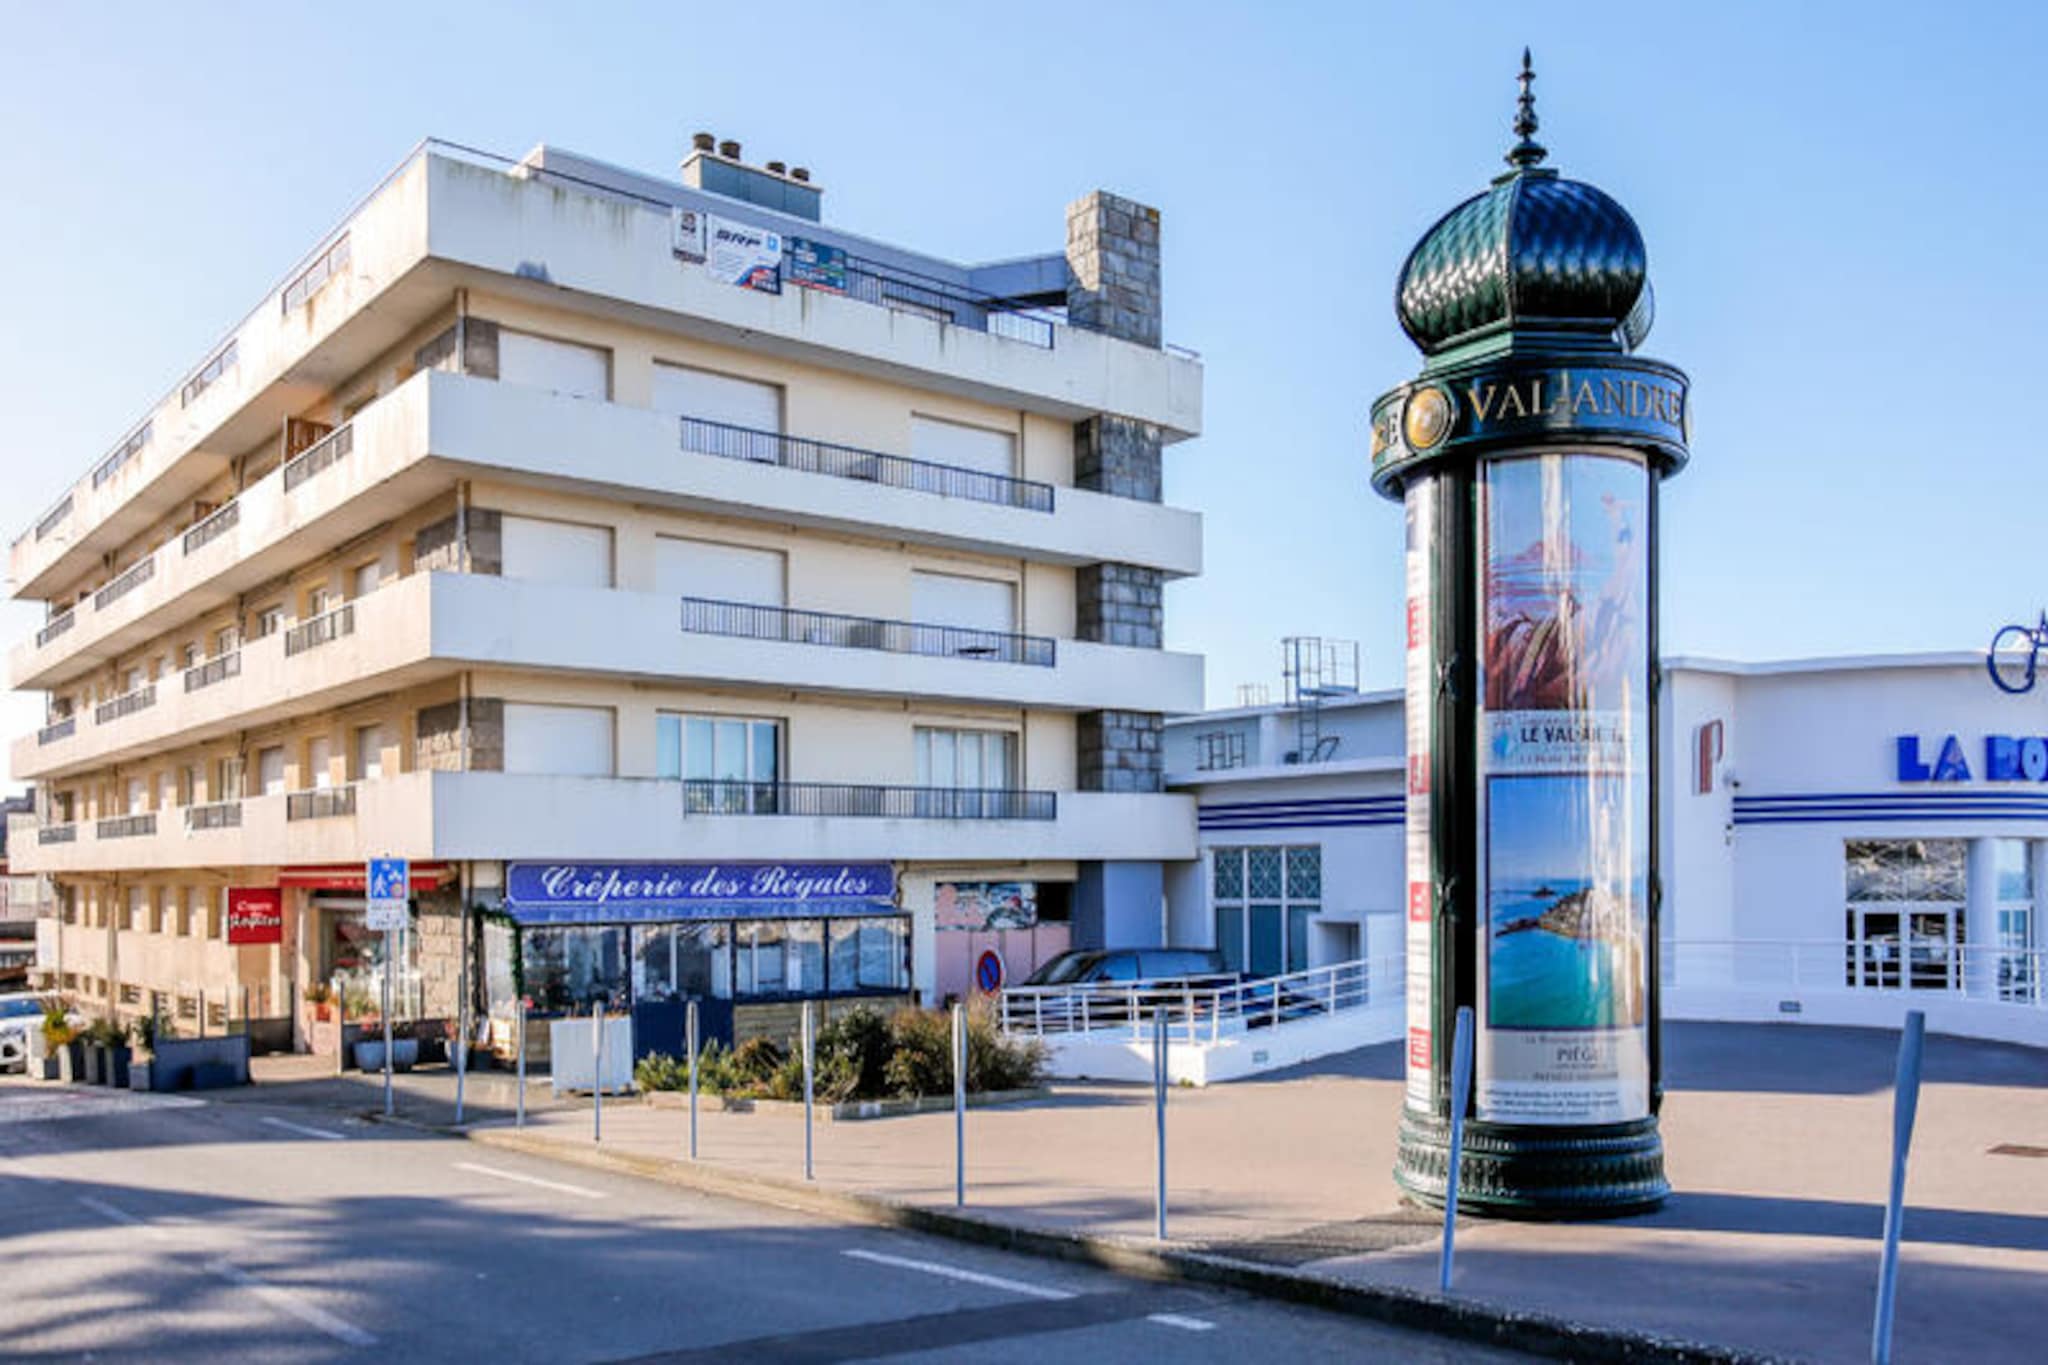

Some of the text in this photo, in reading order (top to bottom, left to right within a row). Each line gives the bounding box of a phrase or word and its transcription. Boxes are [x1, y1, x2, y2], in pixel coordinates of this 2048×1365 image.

[1896, 734, 1972, 782] LA
[541, 865, 871, 903] Crêperie des Régules
